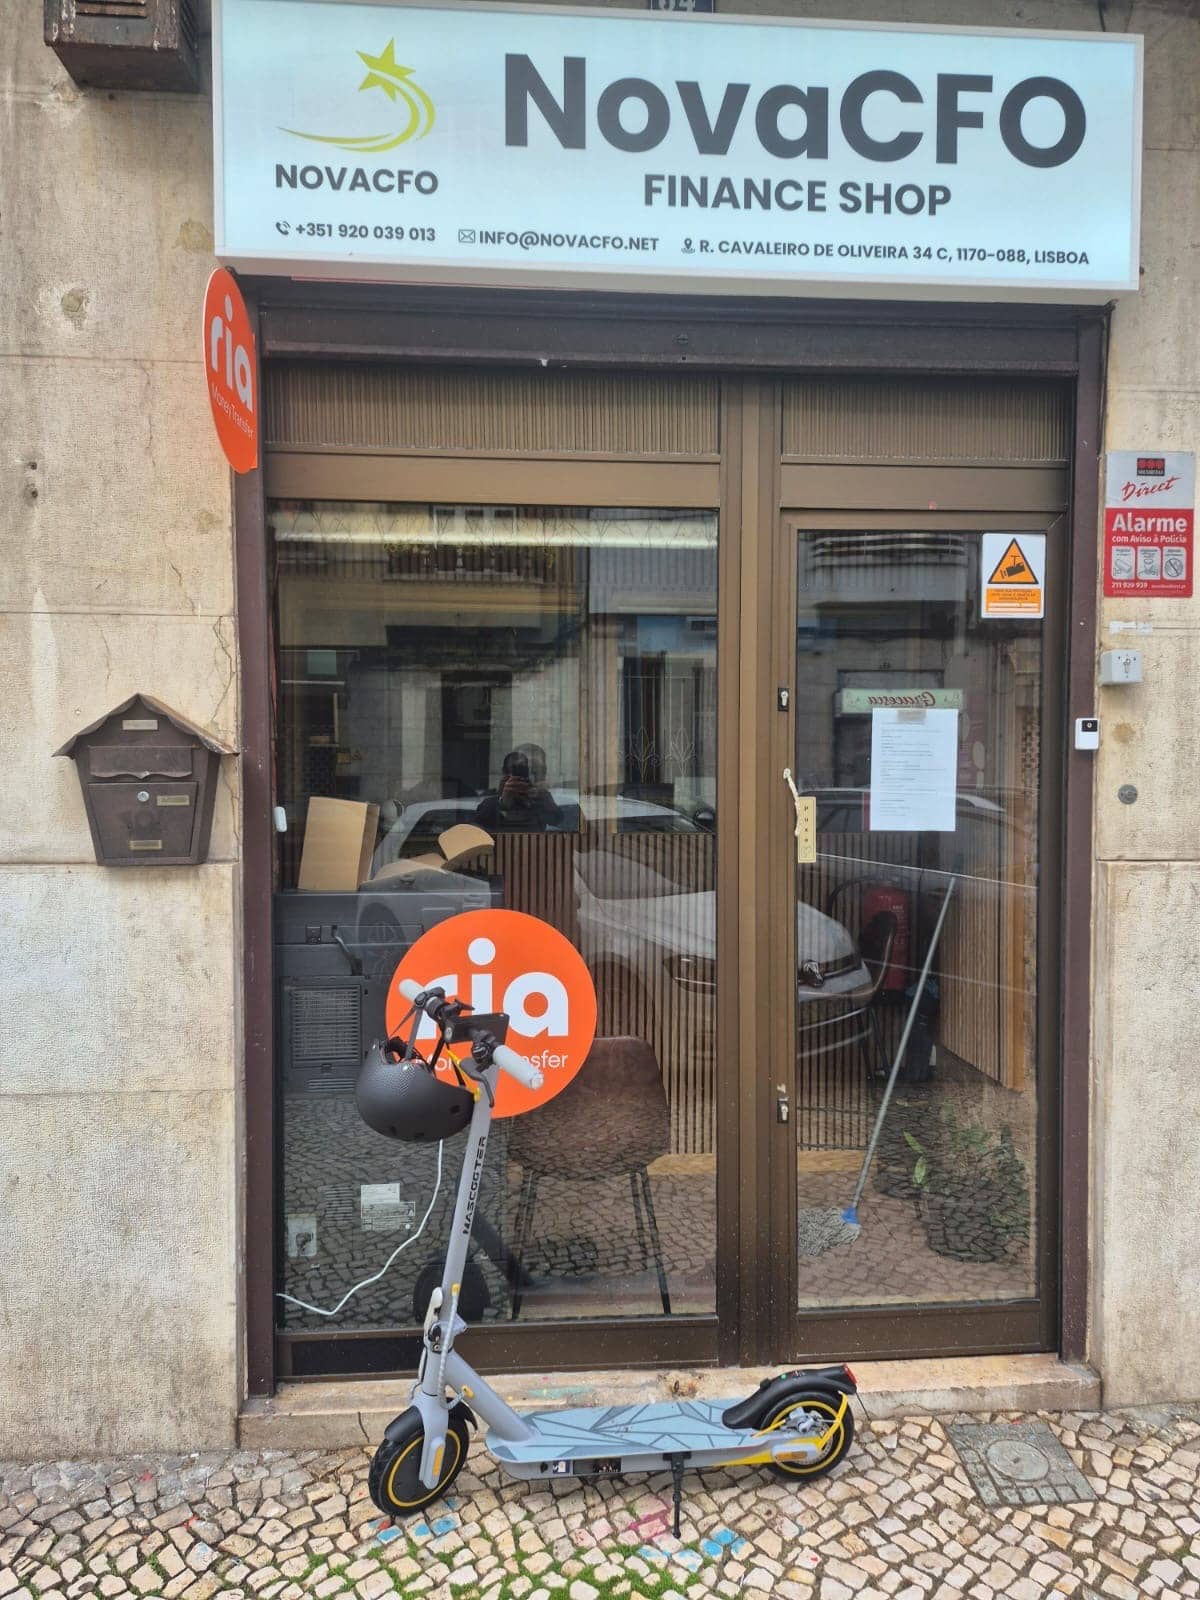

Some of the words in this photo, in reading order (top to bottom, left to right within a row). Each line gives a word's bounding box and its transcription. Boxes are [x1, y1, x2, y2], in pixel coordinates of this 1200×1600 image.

[504, 53, 1087, 168] NovaCFO
[275, 163, 439, 196] NOVACFO
[643, 173, 828, 213] FINANCE
[839, 180, 952, 216] SHOP
[295, 222, 333, 237] +351
[338, 223, 369, 239] 920
[373, 225, 405, 240] 039
[408, 227, 436, 242] 013
[479, 230, 660, 251] INFO@NOVACFO.NET
[699, 239, 715, 254] R.
[718, 240, 810, 257] CAVALEIRO
[813, 243, 833, 258] DE
[837, 244, 909, 260] OLIVEIRA
[912, 246, 933, 261] 34
[936, 247, 953, 263] C,
[957, 247, 1031, 266] 1170-088,
[1034, 249, 1090, 265] LISBOA
[211, 295, 252, 412] ria
[1121, 476, 1182, 501] Direct
[1112, 512, 1187, 533] Alarme
[1112, 534, 1129, 544] com
[1130, 533, 1152, 544] Aviso
[416, 937, 569, 1040] ria
